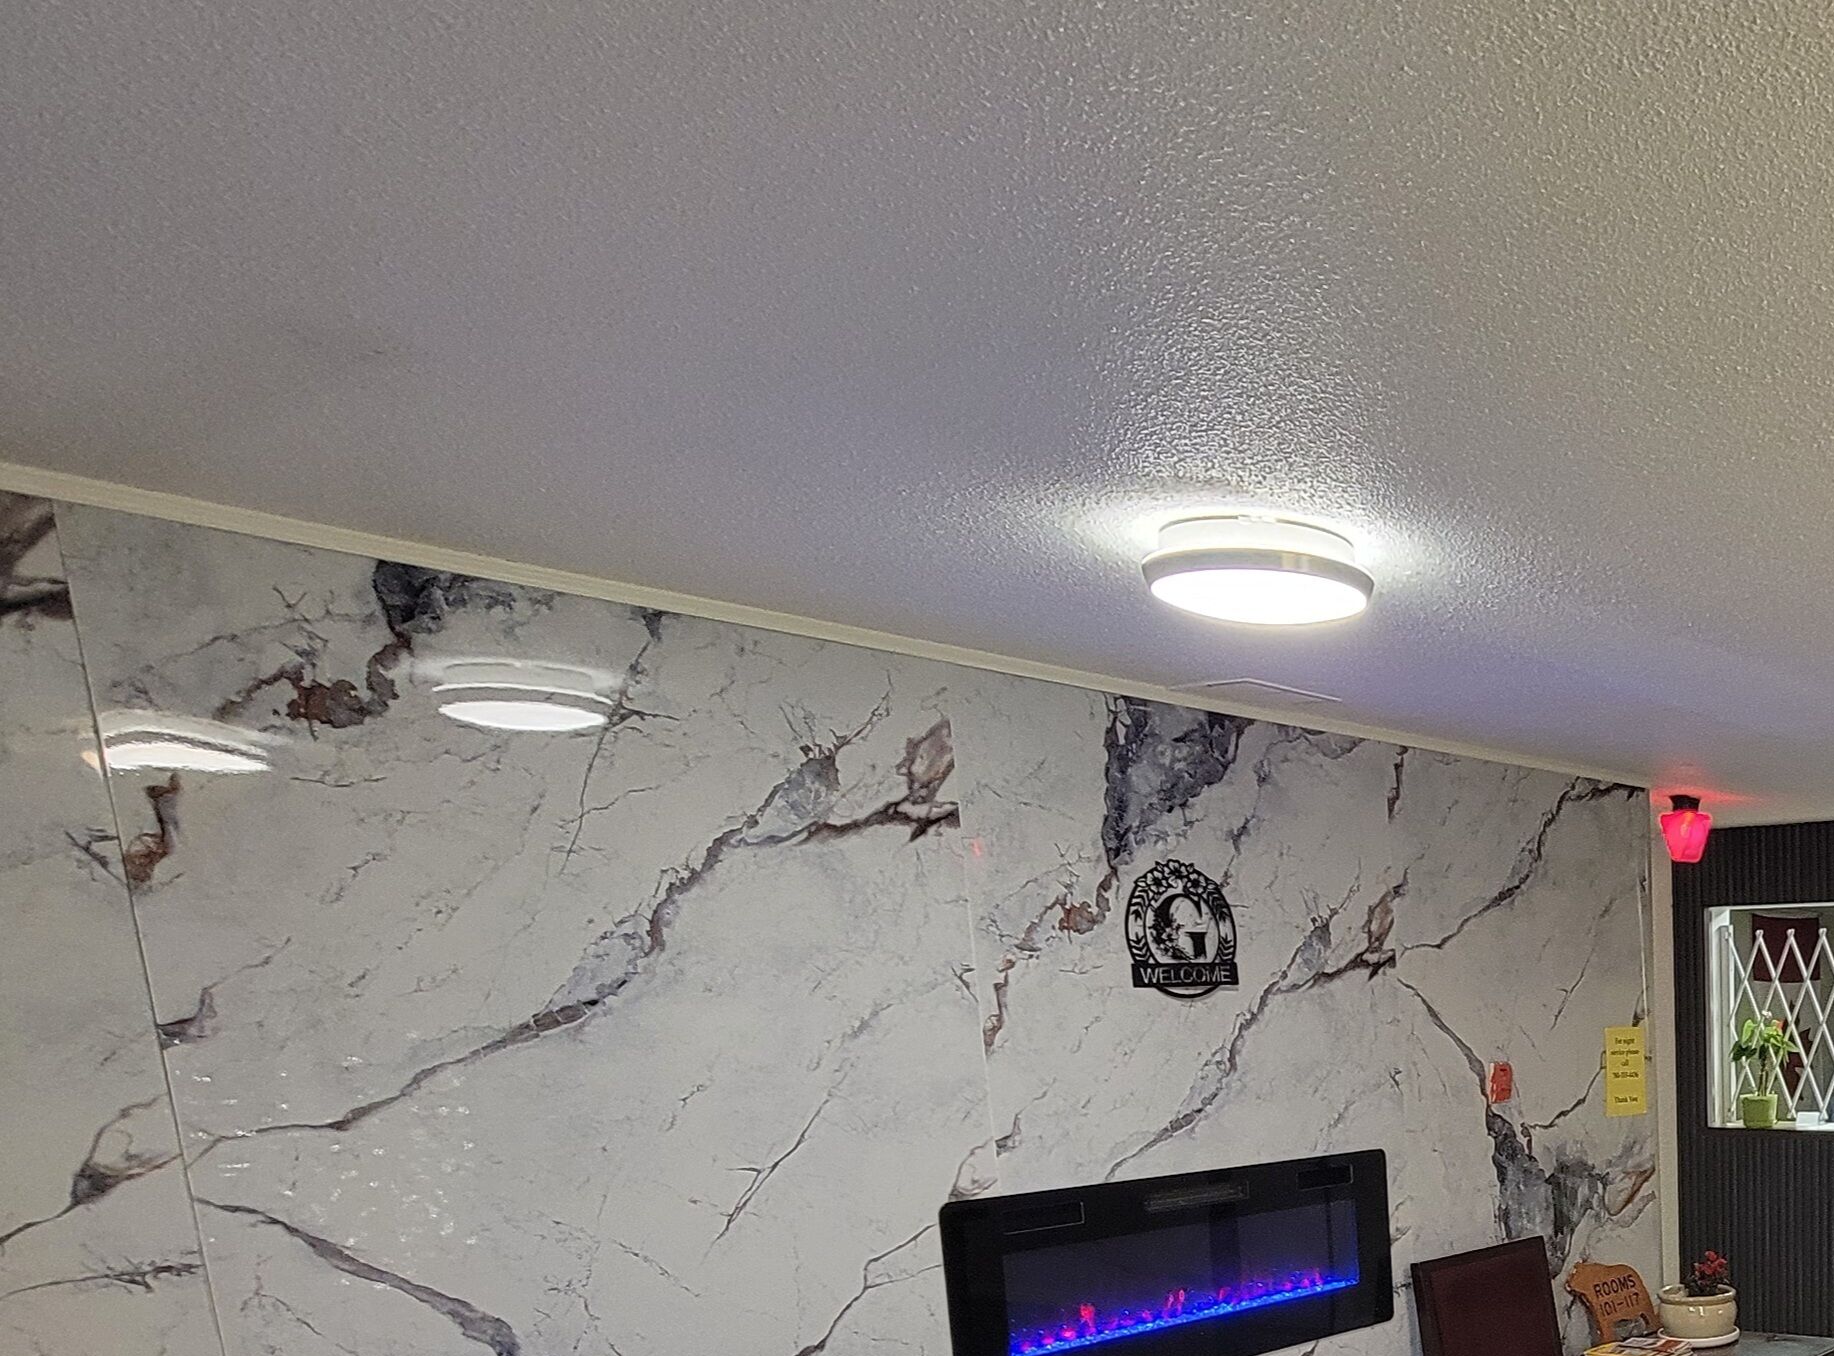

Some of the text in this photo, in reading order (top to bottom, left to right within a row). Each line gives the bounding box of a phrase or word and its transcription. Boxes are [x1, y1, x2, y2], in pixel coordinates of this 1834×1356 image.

[1140, 966, 1233, 984] WELCOME
[1593, 1274, 1637, 1298] ROOMS
[1599, 1291, 1640, 1317] 101-117
